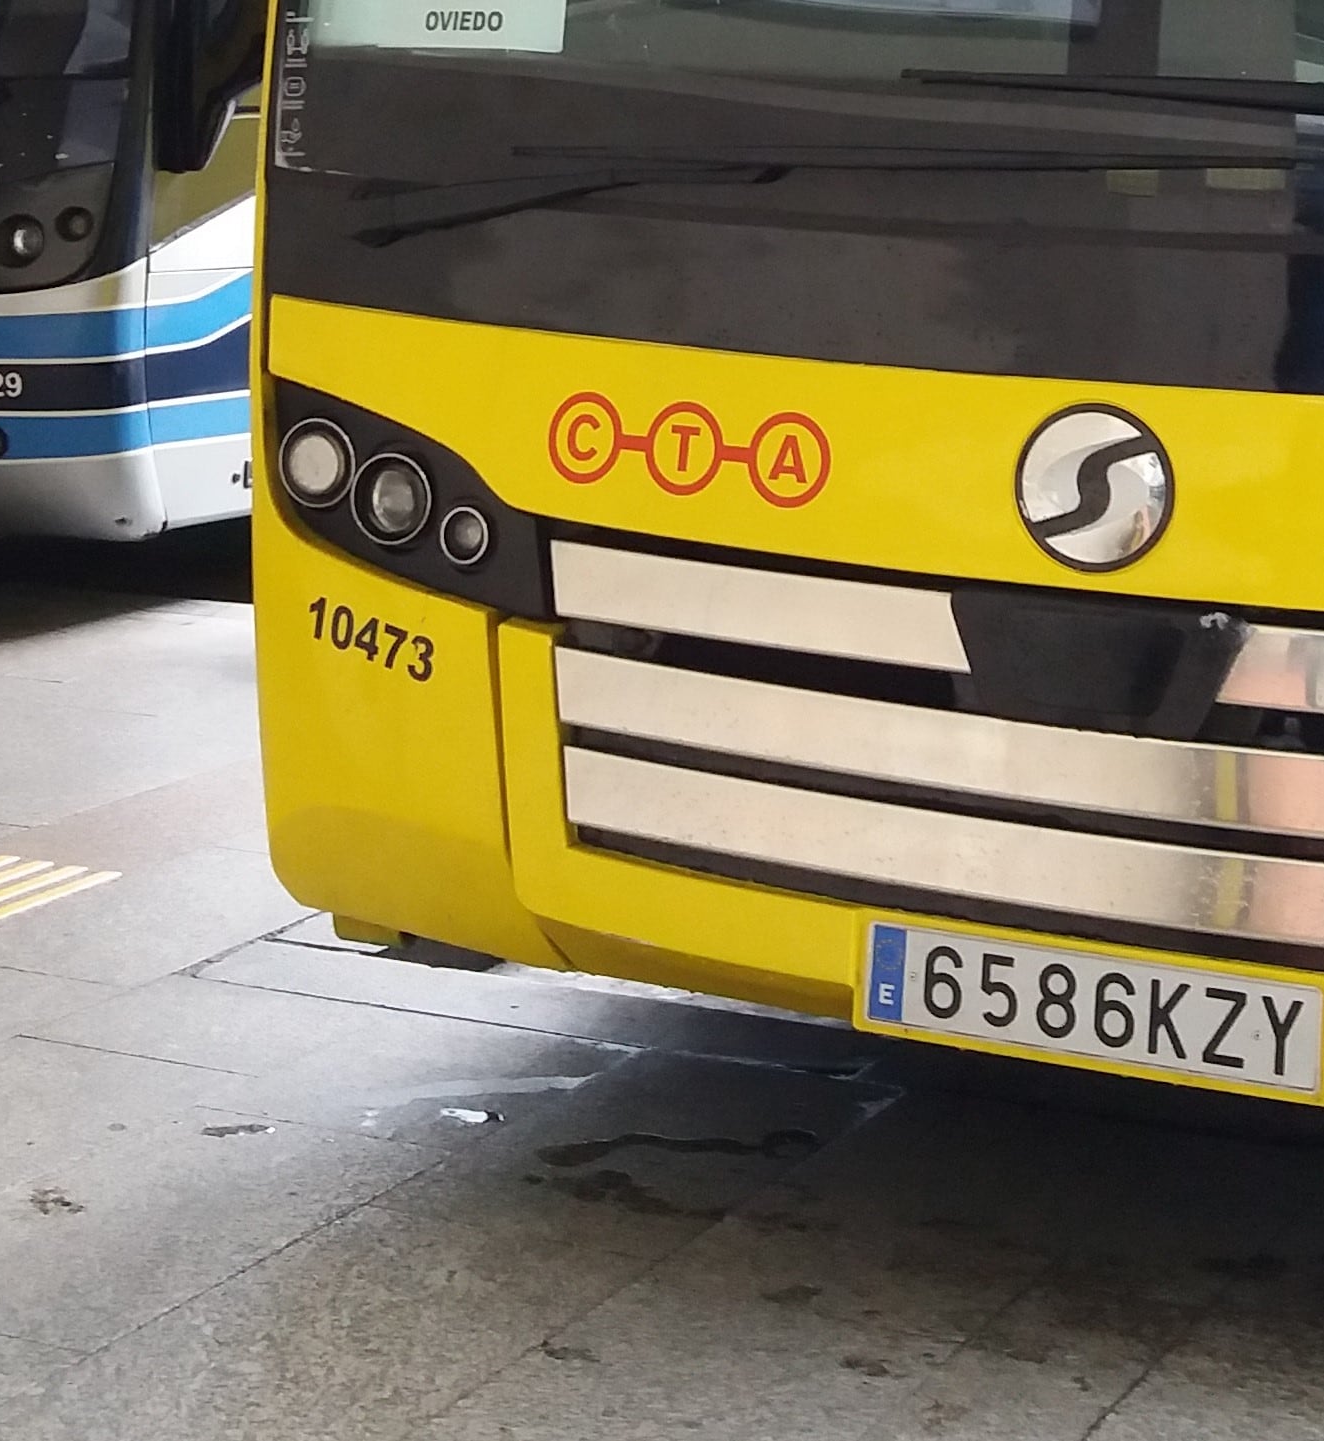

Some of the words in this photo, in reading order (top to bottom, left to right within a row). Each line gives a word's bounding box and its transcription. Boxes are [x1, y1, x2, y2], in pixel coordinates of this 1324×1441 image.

[425, 10, 503, 31] OVIEDO
[308, 597, 435, 683] 10473
[878, 984, 894, 1006] E
[923, 945, 1304, 1076] 6586KZY
